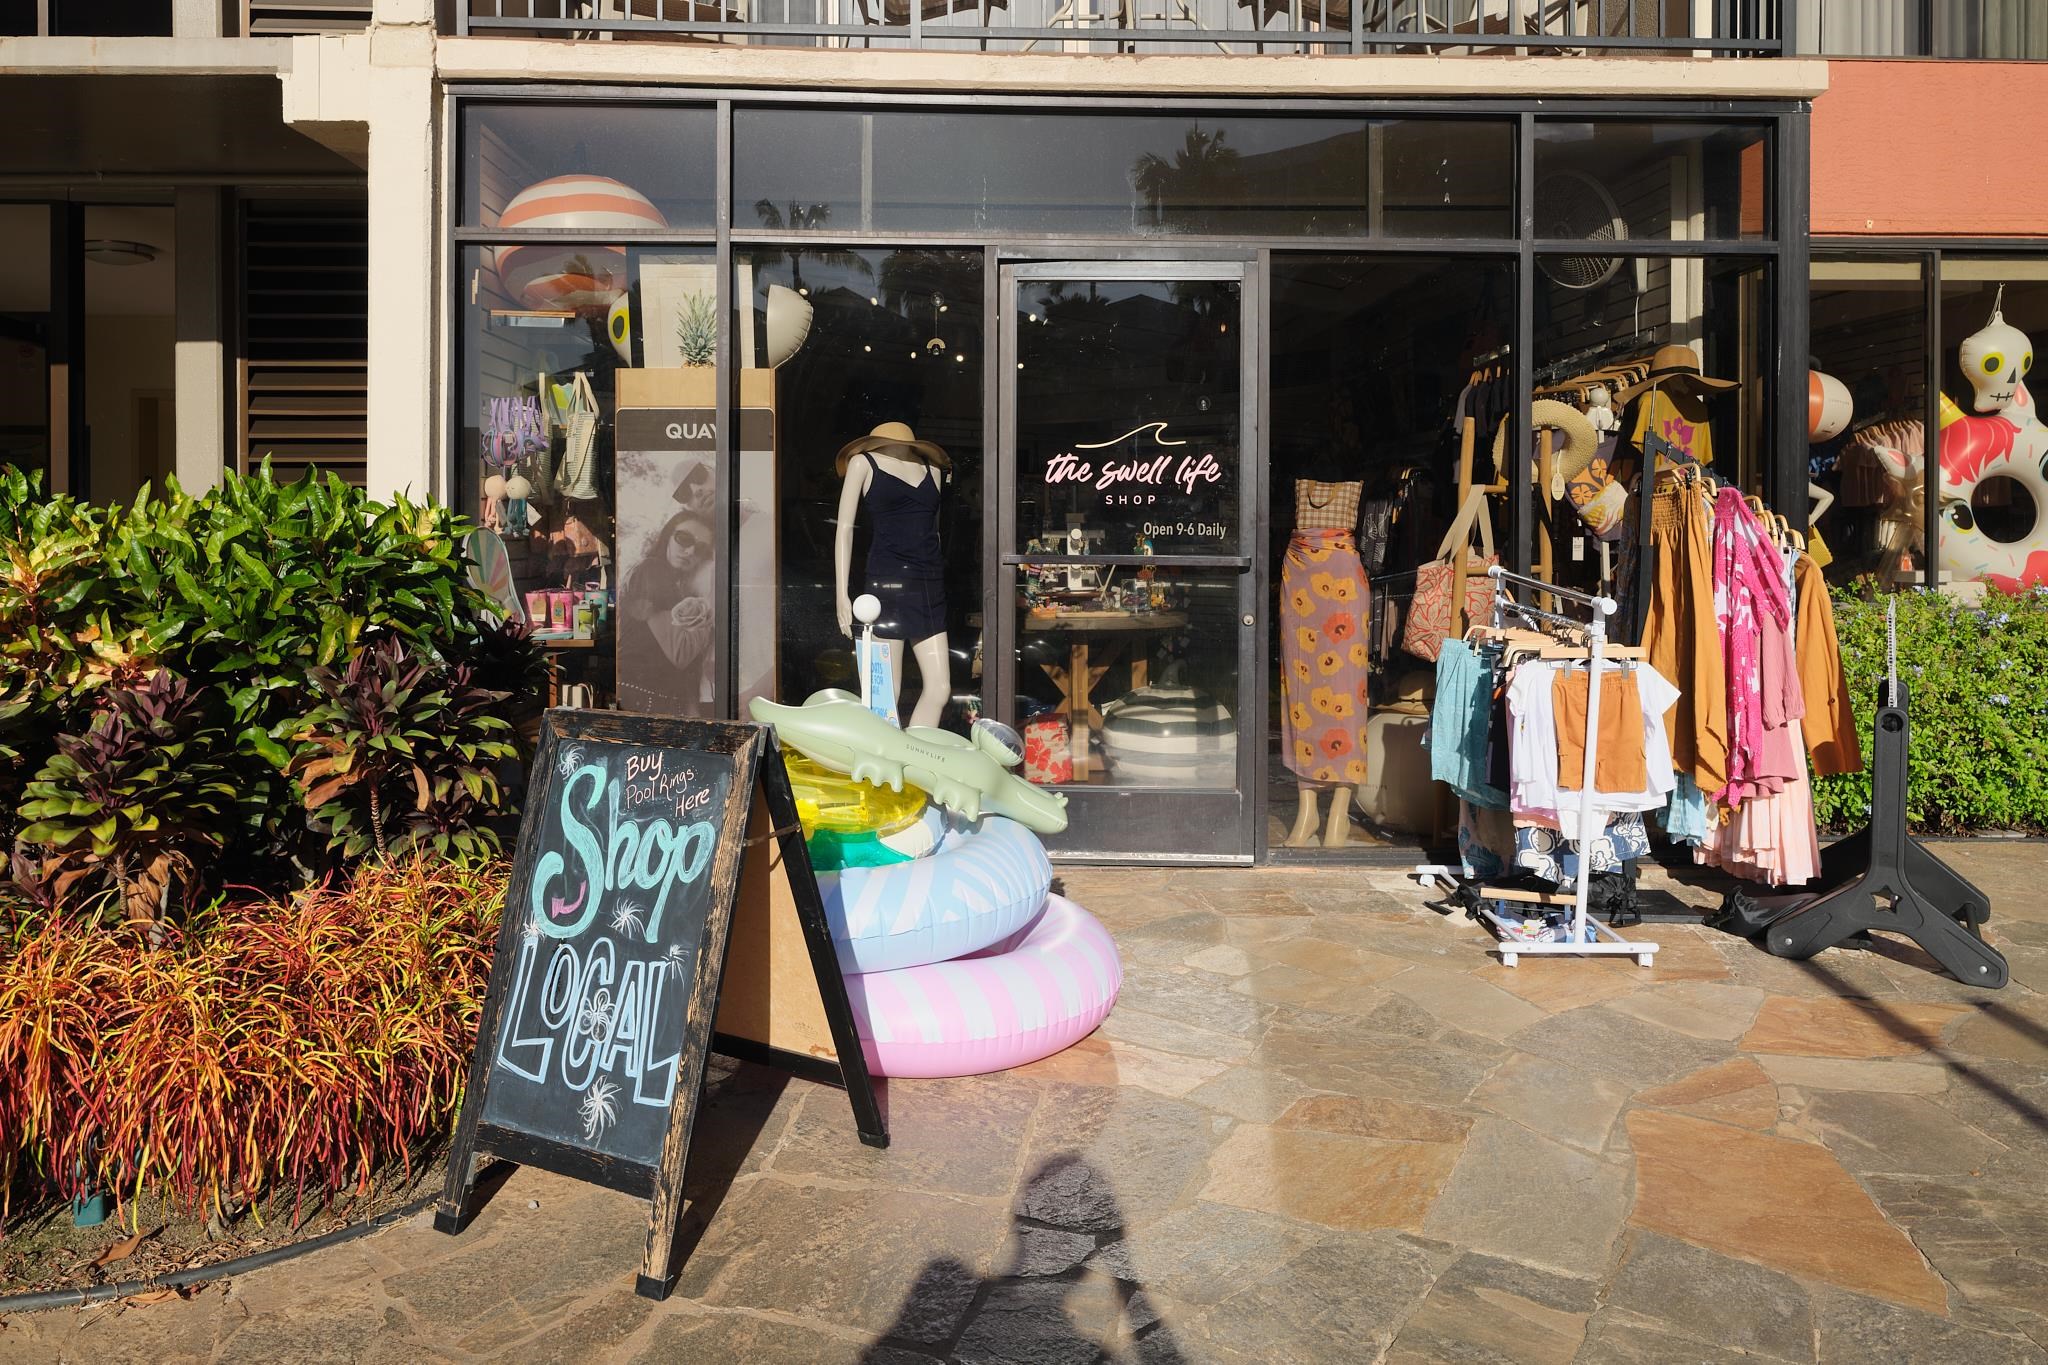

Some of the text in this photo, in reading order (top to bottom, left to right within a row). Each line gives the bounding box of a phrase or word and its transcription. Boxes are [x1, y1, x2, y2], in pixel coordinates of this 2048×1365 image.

[1045, 453, 1222, 495] the swell life
[1105, 495, 1156, 505] SHOP
[1143, 522, 1227, 539] Open 9-6 Daily
[627, 752, 663, 781] Buy
[626, 769, 695, 809] Pool Rings
[675, 788, 710, 818] Here
[531, 763, 716, 944] Shop
[496, 935, 681, 1107] LOCAL
